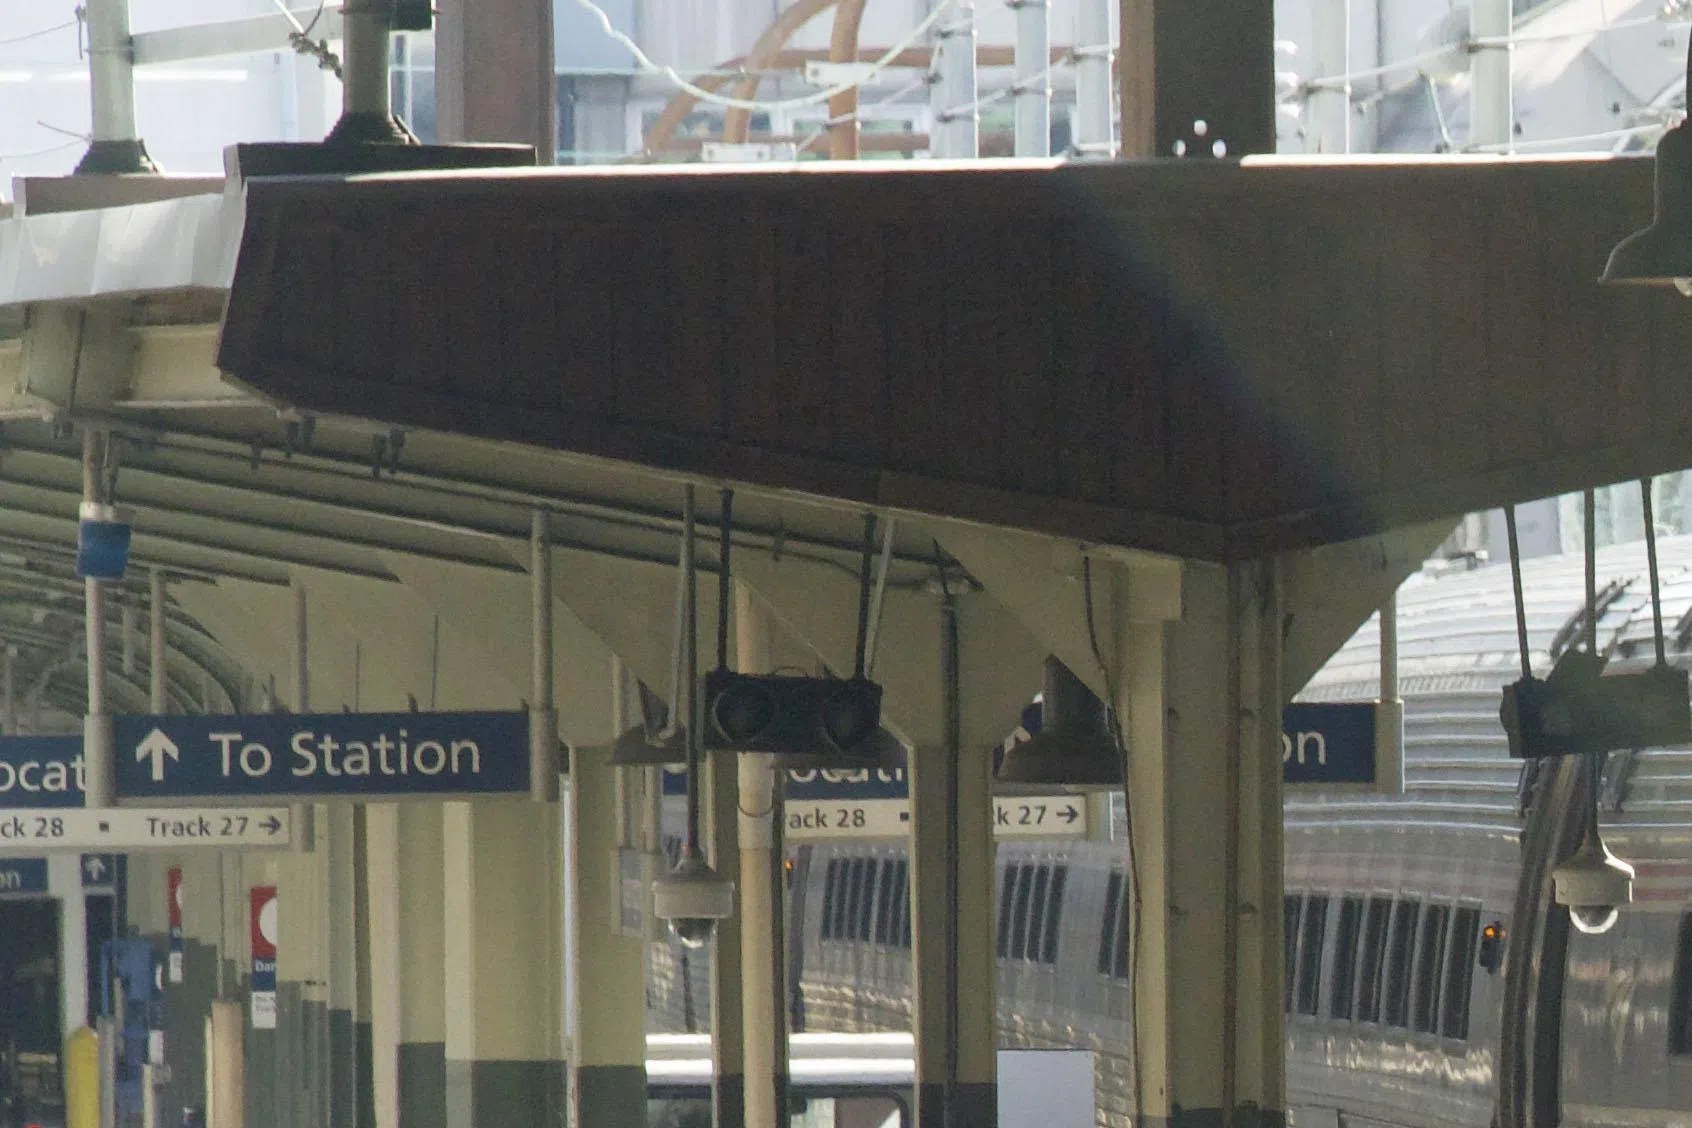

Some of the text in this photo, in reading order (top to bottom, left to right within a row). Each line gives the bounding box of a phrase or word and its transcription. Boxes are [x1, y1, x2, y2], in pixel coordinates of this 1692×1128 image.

[209, 729, 480, 777] To Station
[35, 817, 64, 838] 28
[146, 815, 211, 837] Track
[221, 815, 249, 837] 27
[788, 807, 828, 829] ack
[836, 808, 866, 828] 28
[1018, 804, 1046, 825] 27
